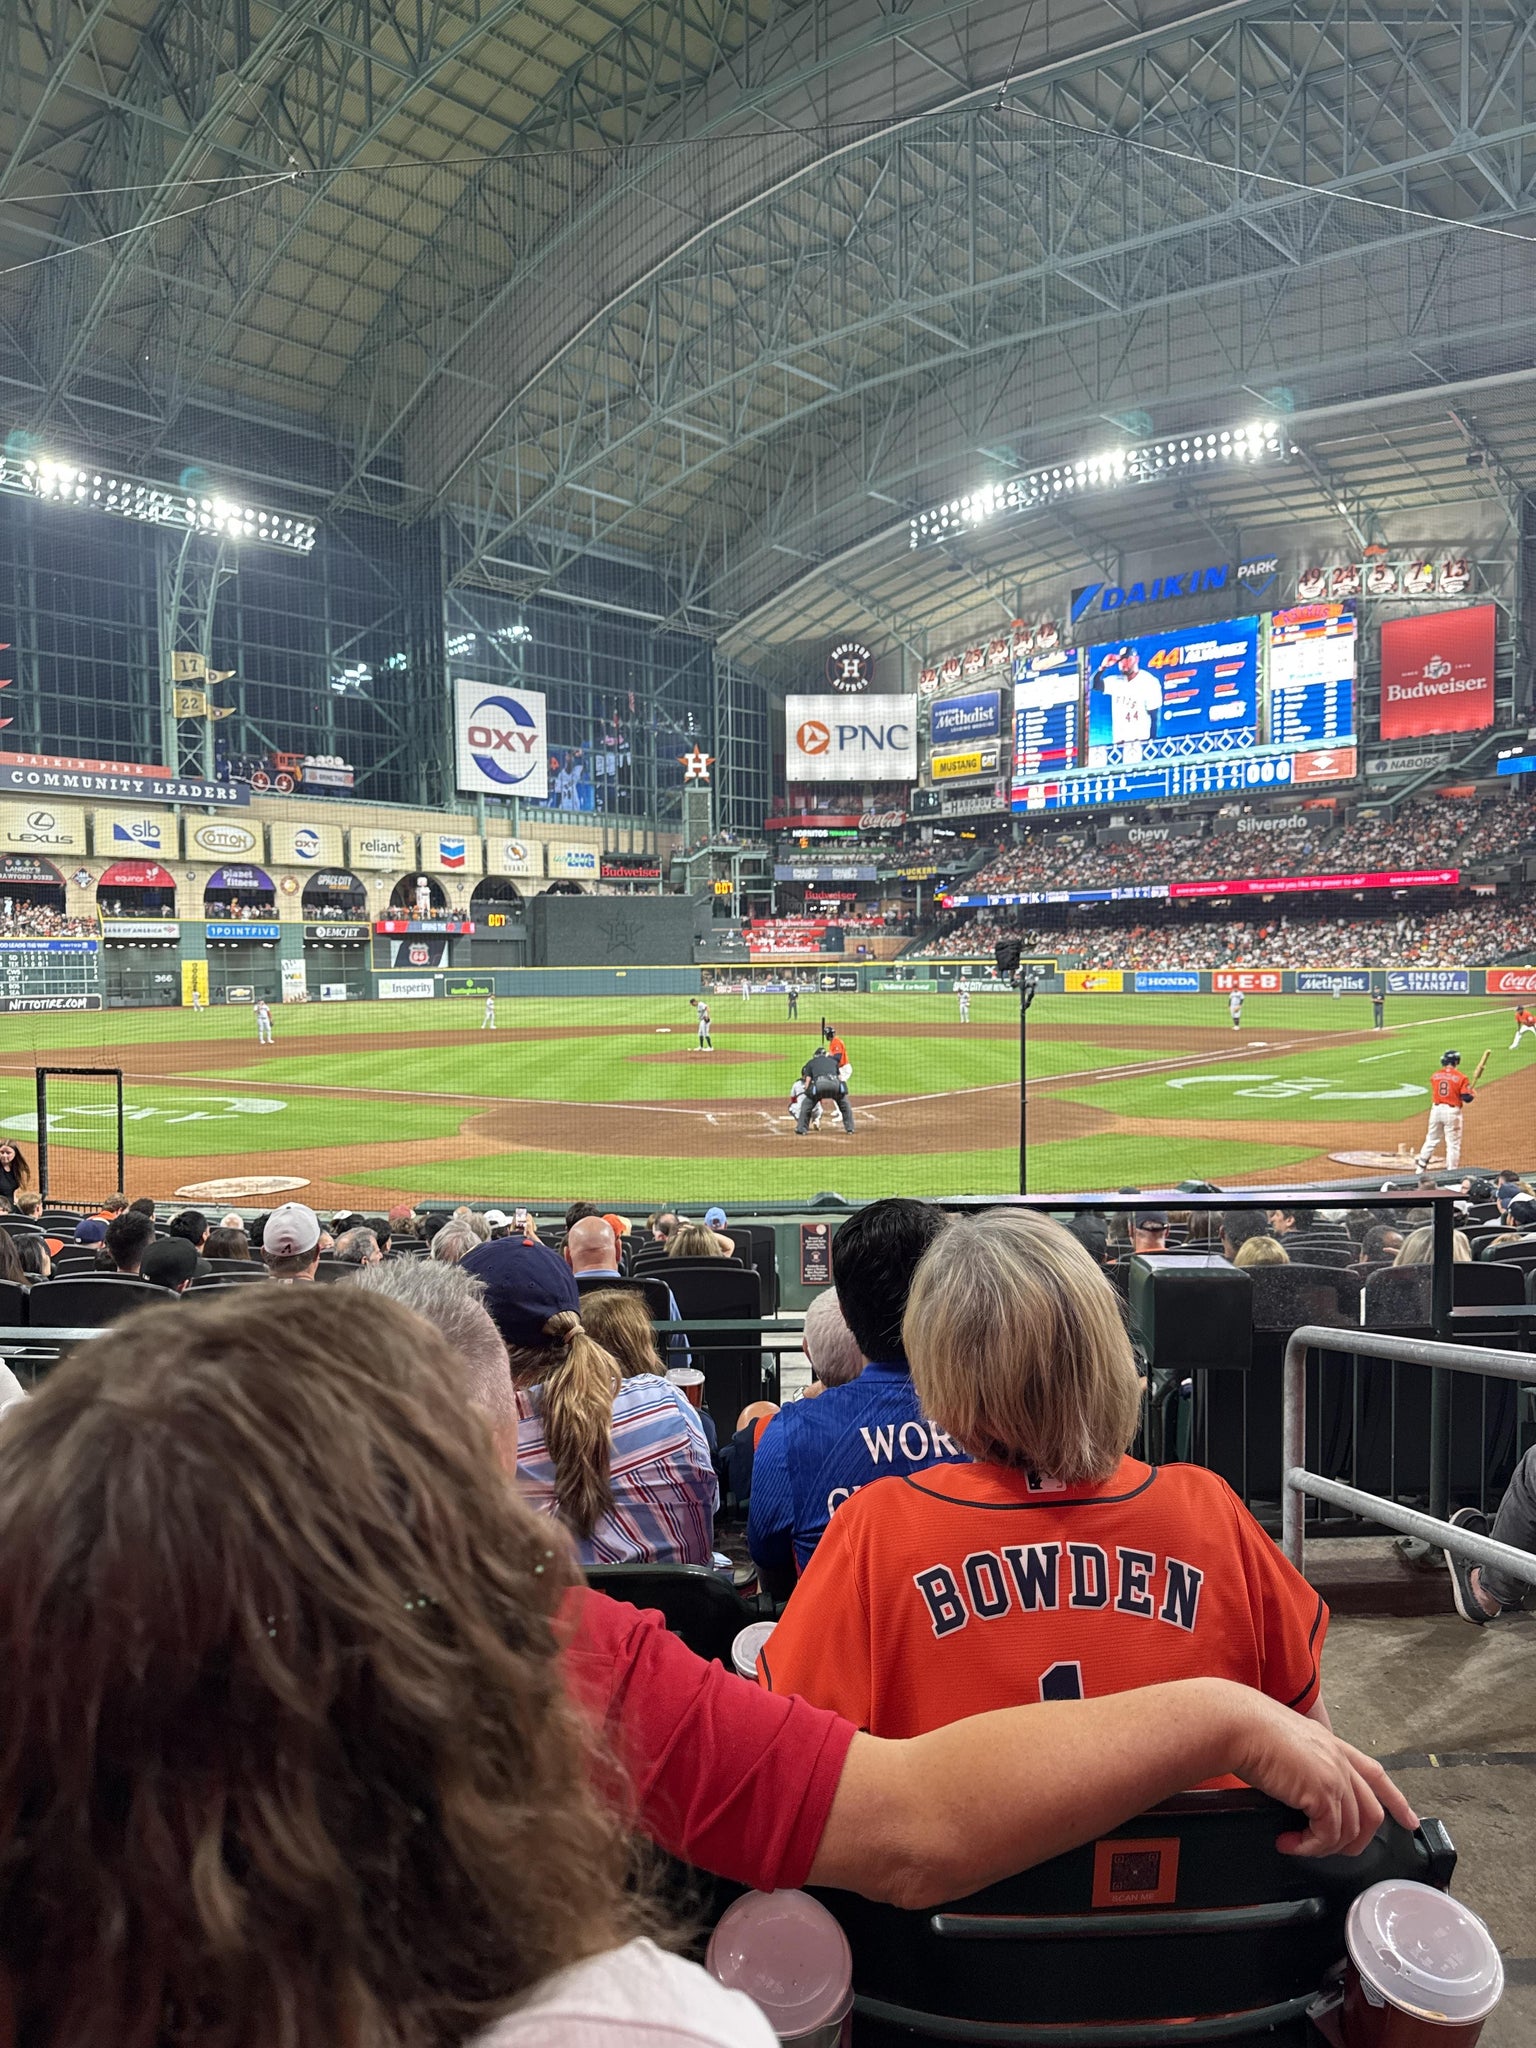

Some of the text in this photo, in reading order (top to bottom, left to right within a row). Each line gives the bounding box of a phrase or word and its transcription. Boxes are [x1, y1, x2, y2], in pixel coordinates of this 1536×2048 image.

[1333, 565, 1356, 583] 24
[1375, 563, 1385, 580] 5
[1411, 563, 1422, 579] 7
[1443, 560, 1466, 578] 13
[1101, 559, 1278, 611] DAIKIN PARK
[832, 643, 870, 660] HOUSTON
[1148, 648, 1181, 669] 44
[180, 659, 198, 672] 17
[842, 659, 860, 678] H
[833, 678, 868, 692] ASTROS
[181, 698, 199, 709] 22
[936, 706, 994, 729] Methodist
[468, 726, 539, 753] OXY
[835, 724, 910, 751] PNC
[100, 763, 143, 774] PARK
[940, 759, 977, 773] MUSTANG
[11, 770, 238, 800] COMMUNITY LEADERS
[132, 820, 160, 838] slb
[1237, 816, 1307, 832] Silverado
[7, 832, 74, 844] LEXUS
[202, 830, 248, 848] COTTON
[1128, 828, 1169, 842] Chevy
[295, 840, 318, 849] OXY
[360, 840, 401, 854] reliant
[223, 869, 253, 880] planet
[601, 866, 661, 877] Budweiser
[115, 874, 145, 884] equinor
[226, 878, 259, 887] fitness
[805, 889, 857, 900] Budweiser
[211, 927, 276, 936] 1POINTFIVE
[326, 927, 359, 937] EMCJET
[940, 966, 1045, 975] LEXS
[1408, 972, 1455, 981] ENERGY
[1148, 977, 1196, 986] HONDA
[1408, 982, 1466, 991] TRANSFER
[392, 983, 432, 995] Insperity
[9, 997, 87, 1010] NITTOTIRE.COM
[1439, 1080, 1448, 1097] 8
[860, 1420, 967, 1465] WOR
[913, 1541, 1203, 1639] BOWDEN
[1112, 1893, 1155, 1902] SCAN ME
